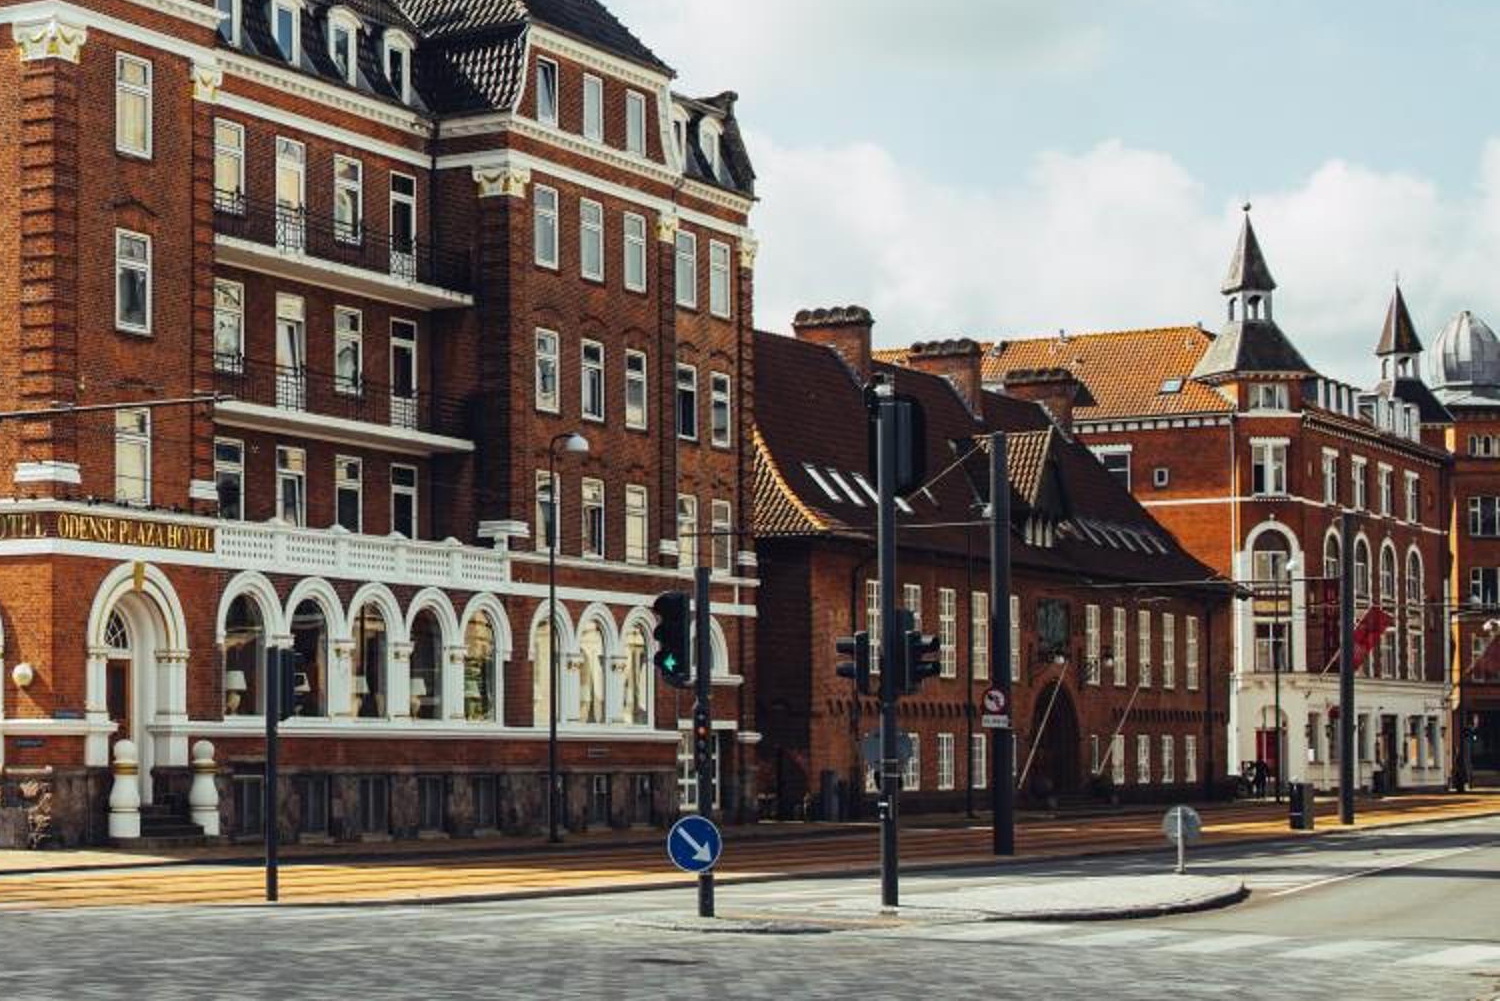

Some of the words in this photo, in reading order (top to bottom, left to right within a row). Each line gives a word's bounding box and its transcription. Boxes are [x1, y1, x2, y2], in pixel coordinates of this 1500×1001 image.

[57, 513, 116, 542] ODENSE
[119, 520, 163, 547] PLAZA
[166, 524, 213, 551] HOTEL
